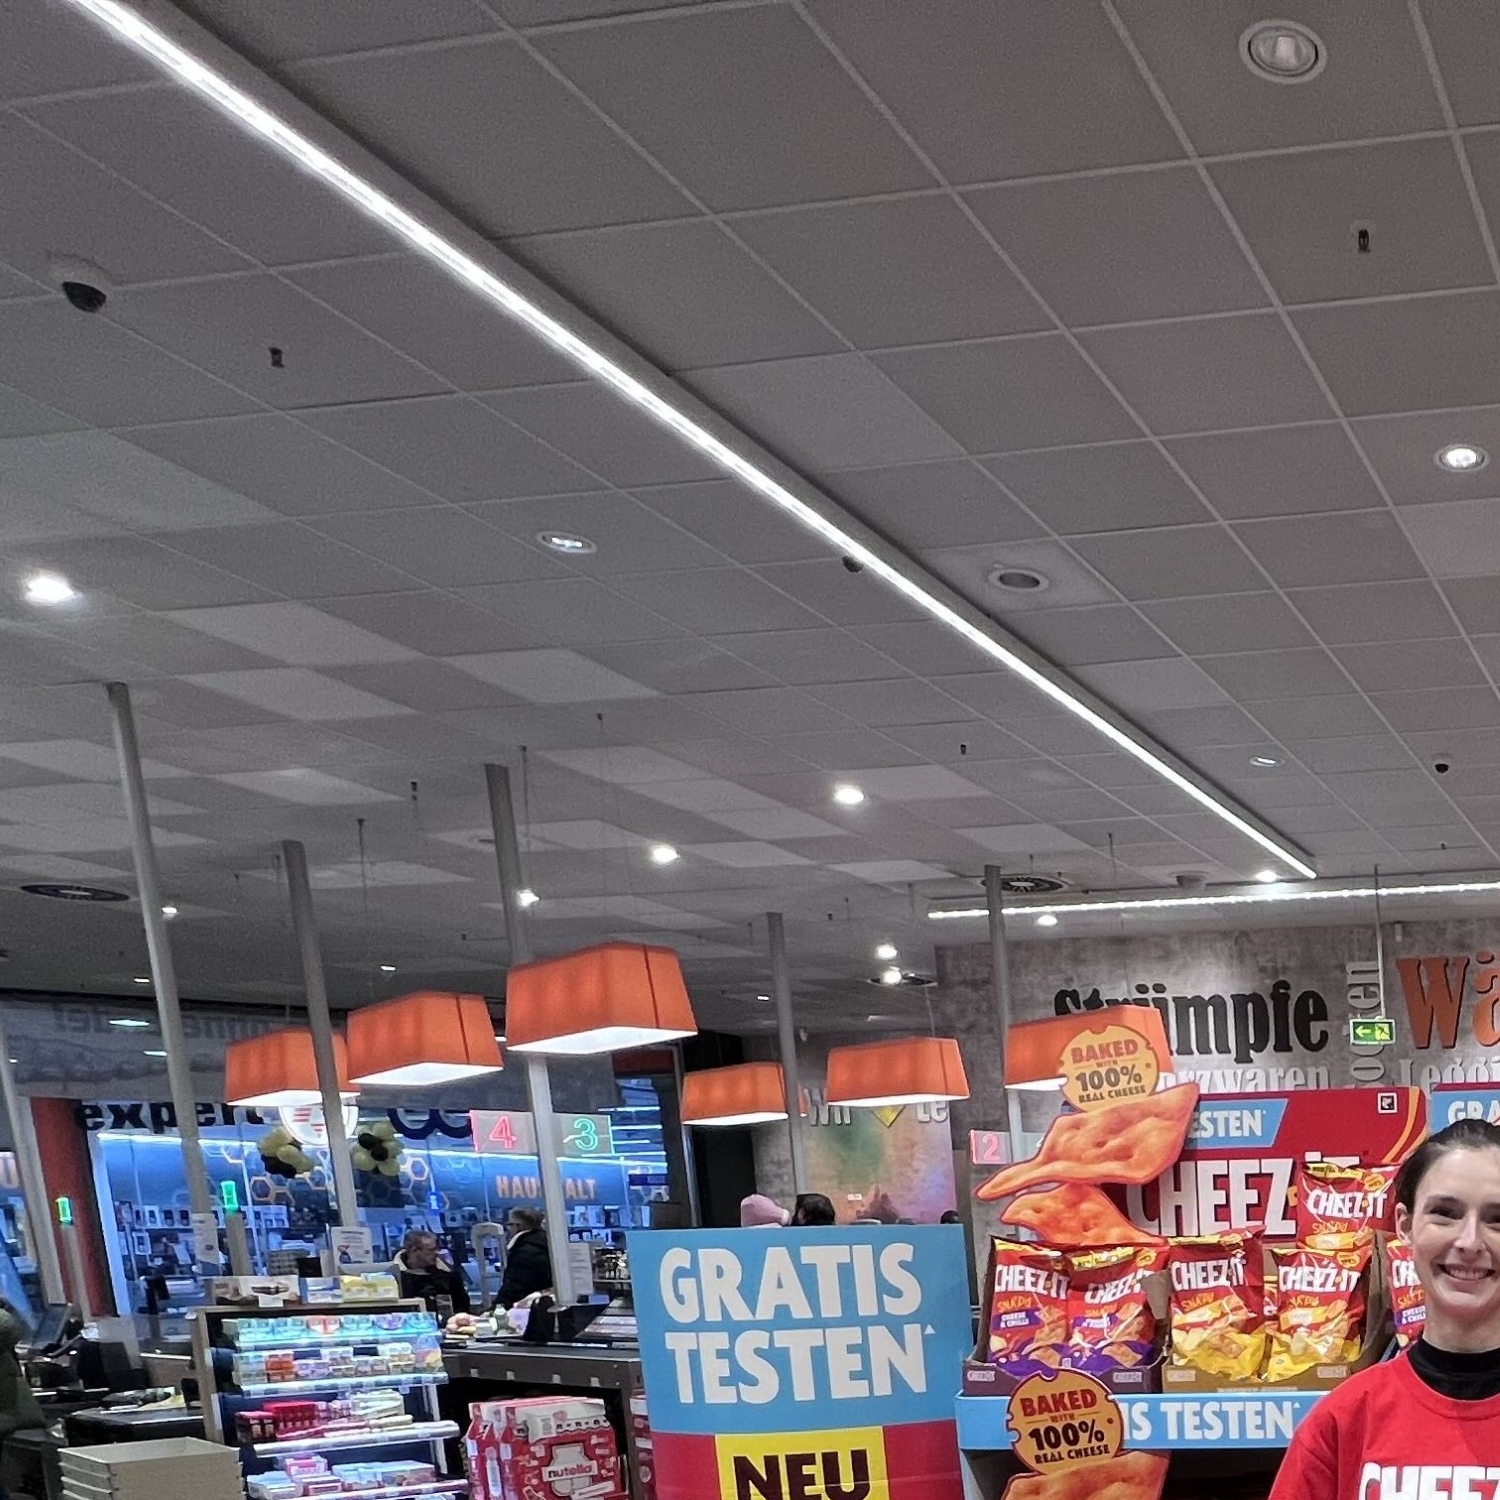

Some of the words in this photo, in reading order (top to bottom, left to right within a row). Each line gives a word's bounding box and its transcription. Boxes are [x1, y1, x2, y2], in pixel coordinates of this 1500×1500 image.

[1071, 1039, 1139, 1064] BAKED
[1075, 1066, 1143, 1092] 100%
[1078, 1089, 1105, 1102] REAL
[1107, 1084, 1147, 1100] CHEESE
[489, 1115, 517, 1149] 4
[574, 1118, 599, 1150] 3
[1190, 1110, 1263, 1138] ESTEN
[981, 1133, 1000, 1161] 2
[495, 1175, 597, 1199] HAUALT
[659, 1243, 922, 1323] GRATIS
[665, 1323, 929, 1404] TESTEN
[1020, 1388, 1098, 1417] BAKED
[1028, 1419, 1105, 1452] 100%
[1160, 1402, 1294, 1441] TESTEN
[1034, 1450, 1066, 1464] REAL
[1068, 1444, 1110, 1460] CHEESE
[548, 1464, 592, 1479] nutella
